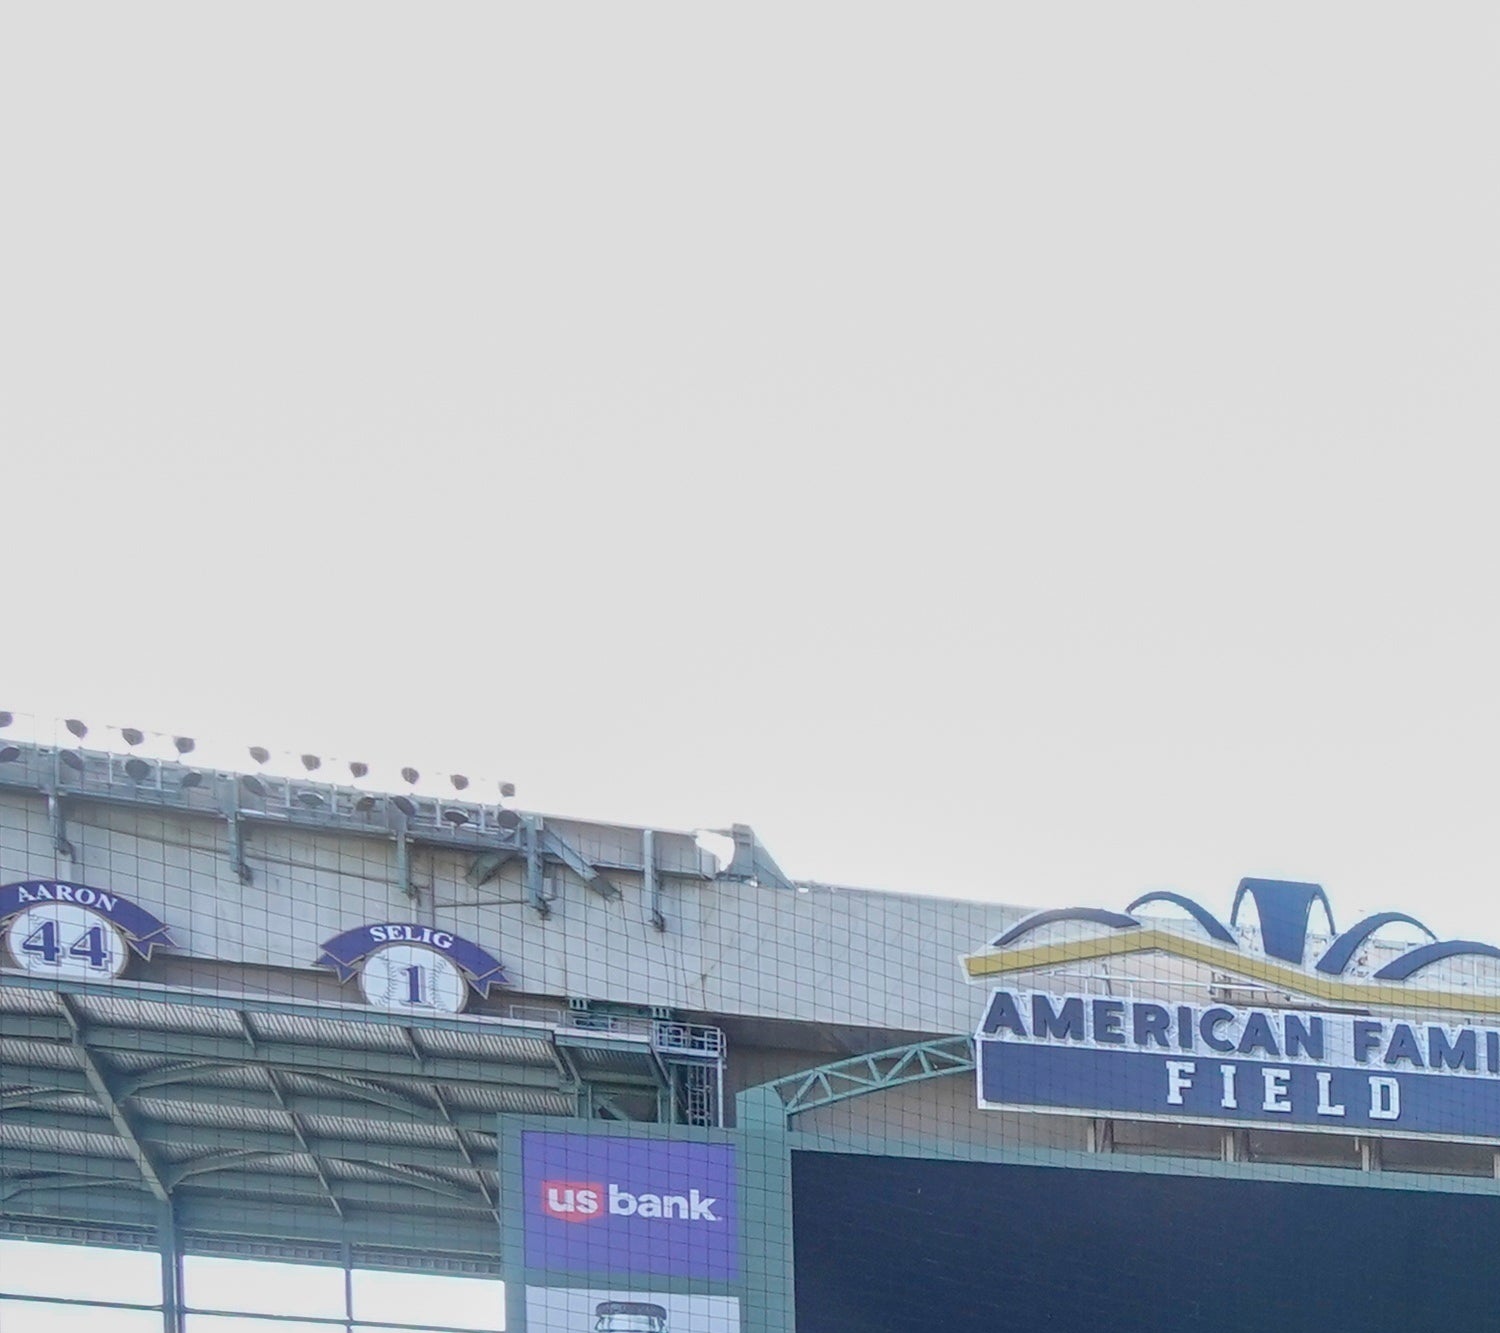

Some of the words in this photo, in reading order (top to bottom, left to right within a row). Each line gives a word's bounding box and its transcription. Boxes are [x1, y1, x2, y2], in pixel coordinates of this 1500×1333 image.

[18, 885, 118, 912] AARON
[22, 920, 112, 971] 44
[369, 923, 454, 950] SELIG
[401, 965, 426, 1004] 1
[984, 992, 1325, 1060] AMERICAN
[1167, 1062, 1402, 1120] FIELD
[546, 1187, 599, 1215] us
[609, 1184, 717, 1221] bank
